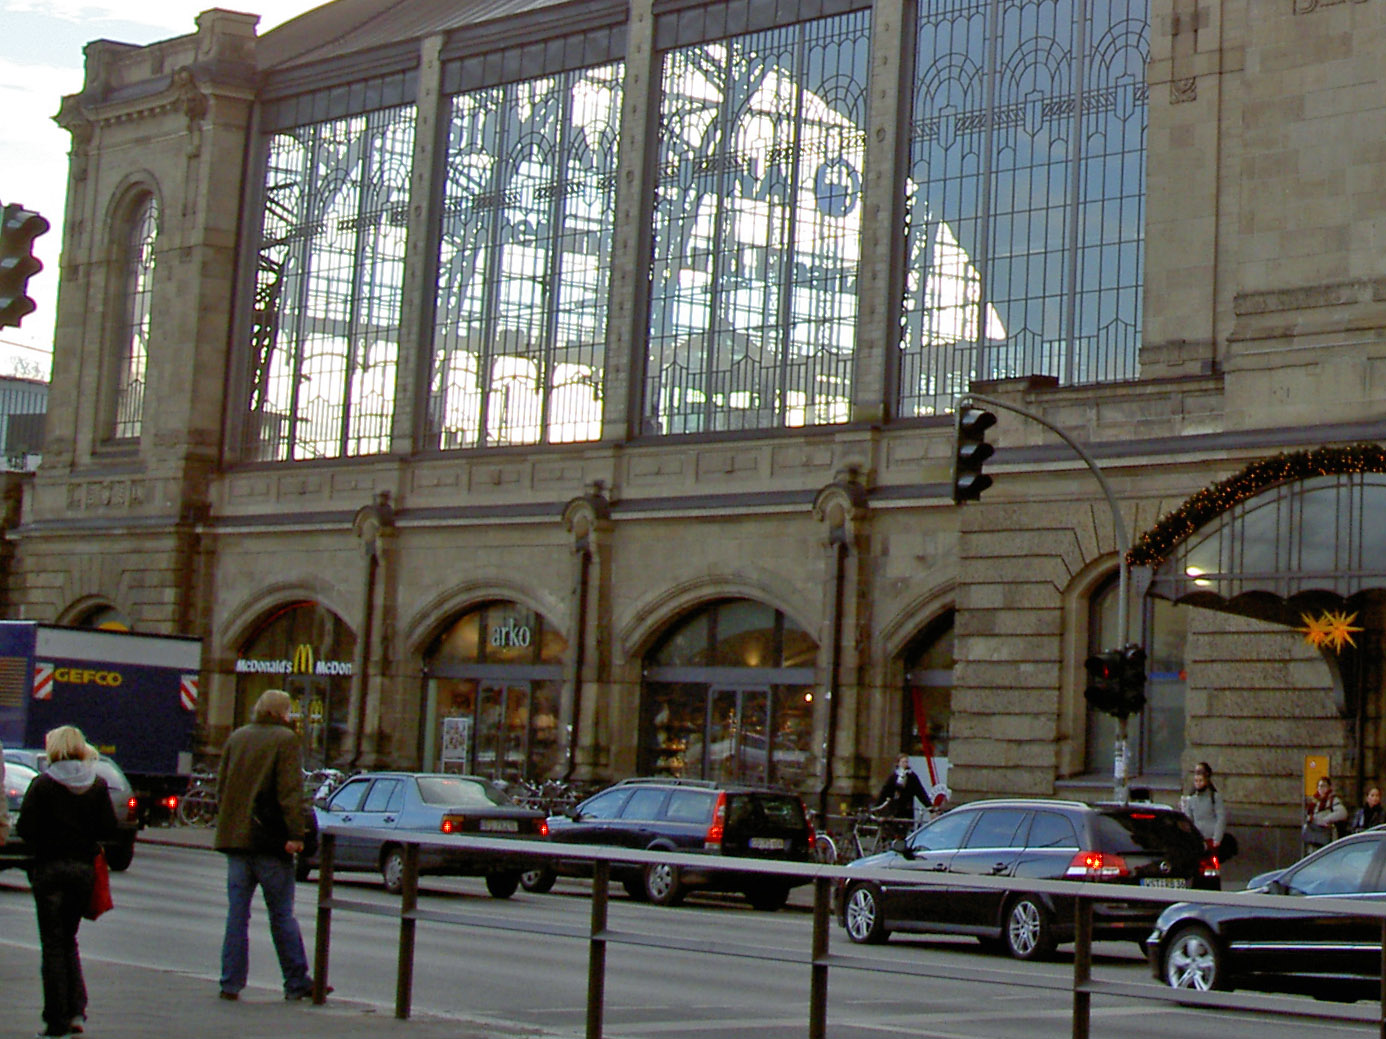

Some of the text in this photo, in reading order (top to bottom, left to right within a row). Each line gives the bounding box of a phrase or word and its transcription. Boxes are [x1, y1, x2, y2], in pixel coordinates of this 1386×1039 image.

[491, 618, 531, 648] arko
[236, 659, 293, 673] McDonald's
[54, 668, 123, 687] GEFCO
